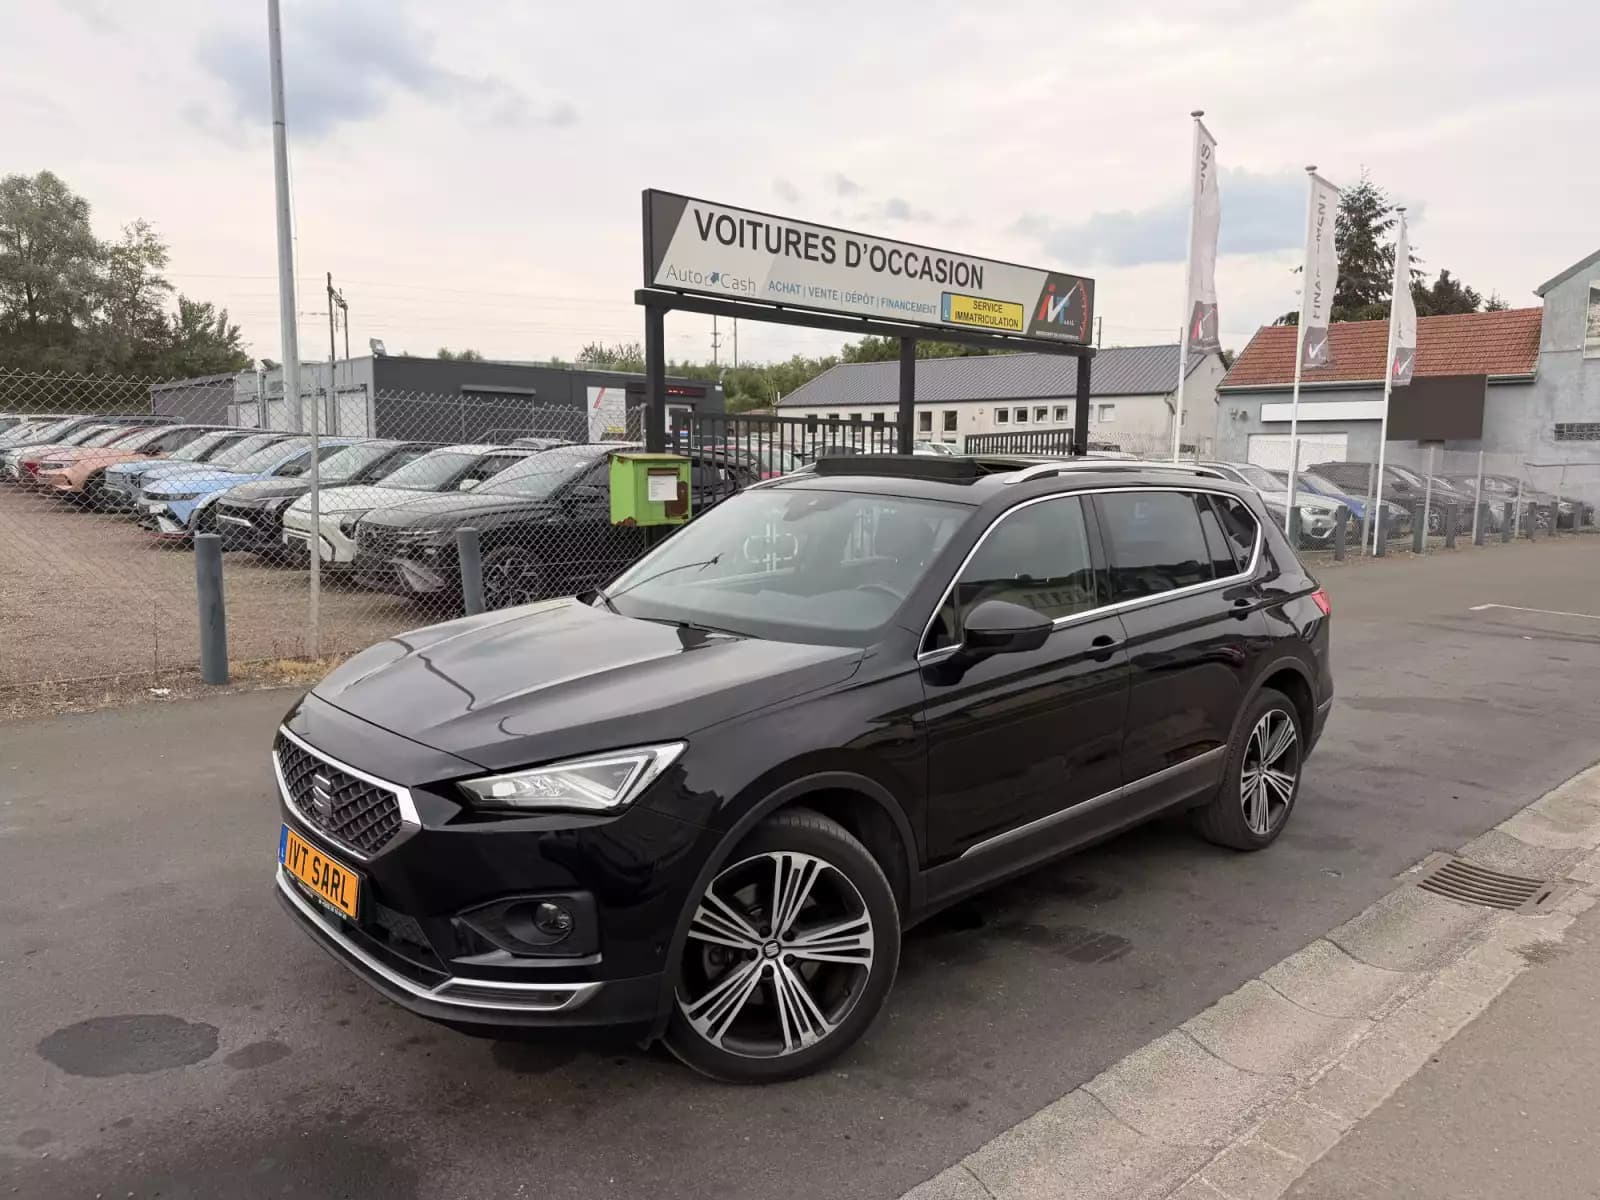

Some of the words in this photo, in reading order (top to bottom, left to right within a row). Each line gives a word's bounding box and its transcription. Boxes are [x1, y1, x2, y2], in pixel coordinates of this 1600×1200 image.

[694, 209, 836, 264] VOITURES
[845, 240, 984, 290] D'OCCASION
[666, 264, 703, 284] Auto
[720, 273, 756, 293] Cash
[768, 280, 801, 295] ACHAT
[808, 286, 838, 301] VENTE
[845, 291, 875, 305] DÉPÔT
[881, 298, 937, 315] FINANCEMENT
[973, 300, 1003, 313] SERVICE
[955, 311, 1019, 327] IMMATRICULATION
[288, 838, 309, 877] IVT
[311, 856, 349, 909] SARL
